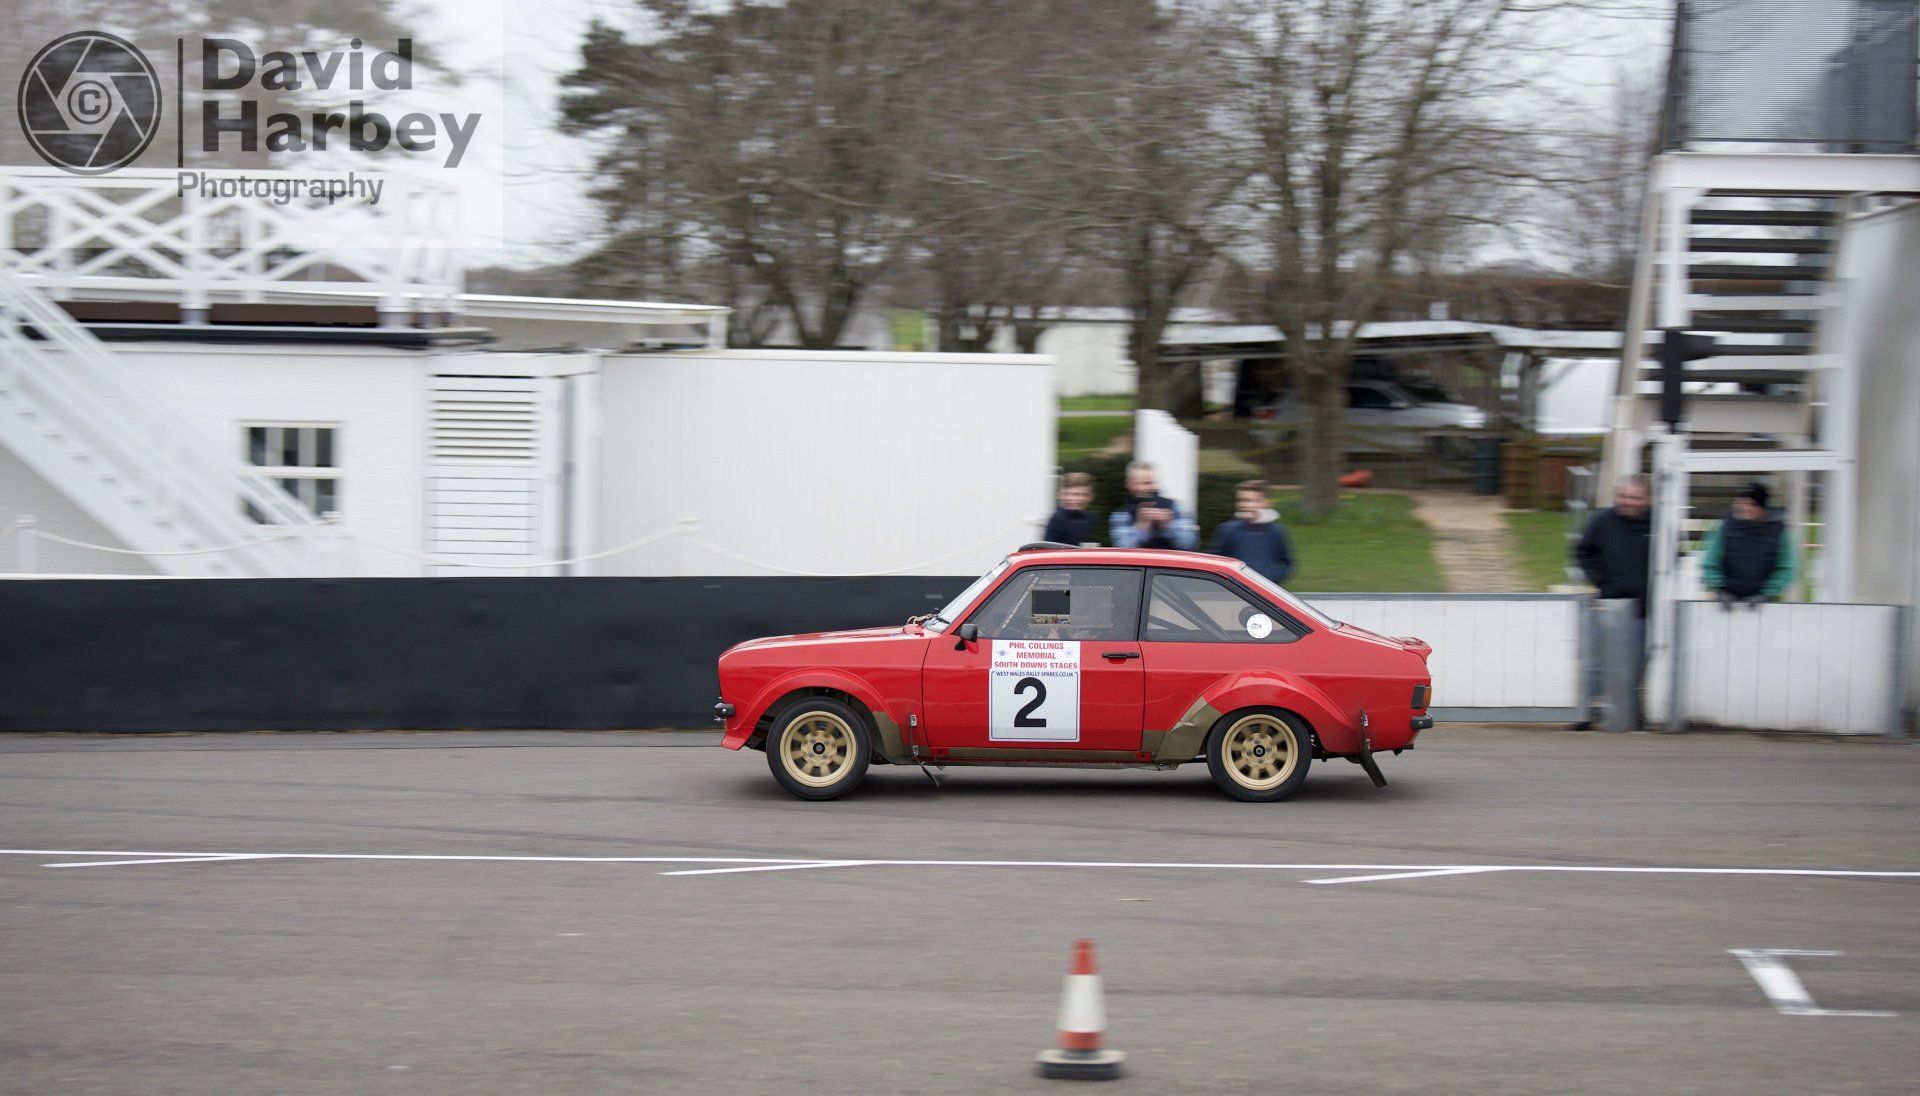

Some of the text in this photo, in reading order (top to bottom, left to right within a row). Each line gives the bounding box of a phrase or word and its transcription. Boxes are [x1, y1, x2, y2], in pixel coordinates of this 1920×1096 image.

[1028, 642, 1064, 650] COLLINGS
[1016, 652, 1056, 660] MEMORIAL
[994, 661, 1018, 669] SOUTH
[1049, 662, 1078, 670] STAGES
[1013, 676, 1047, 728] 2
